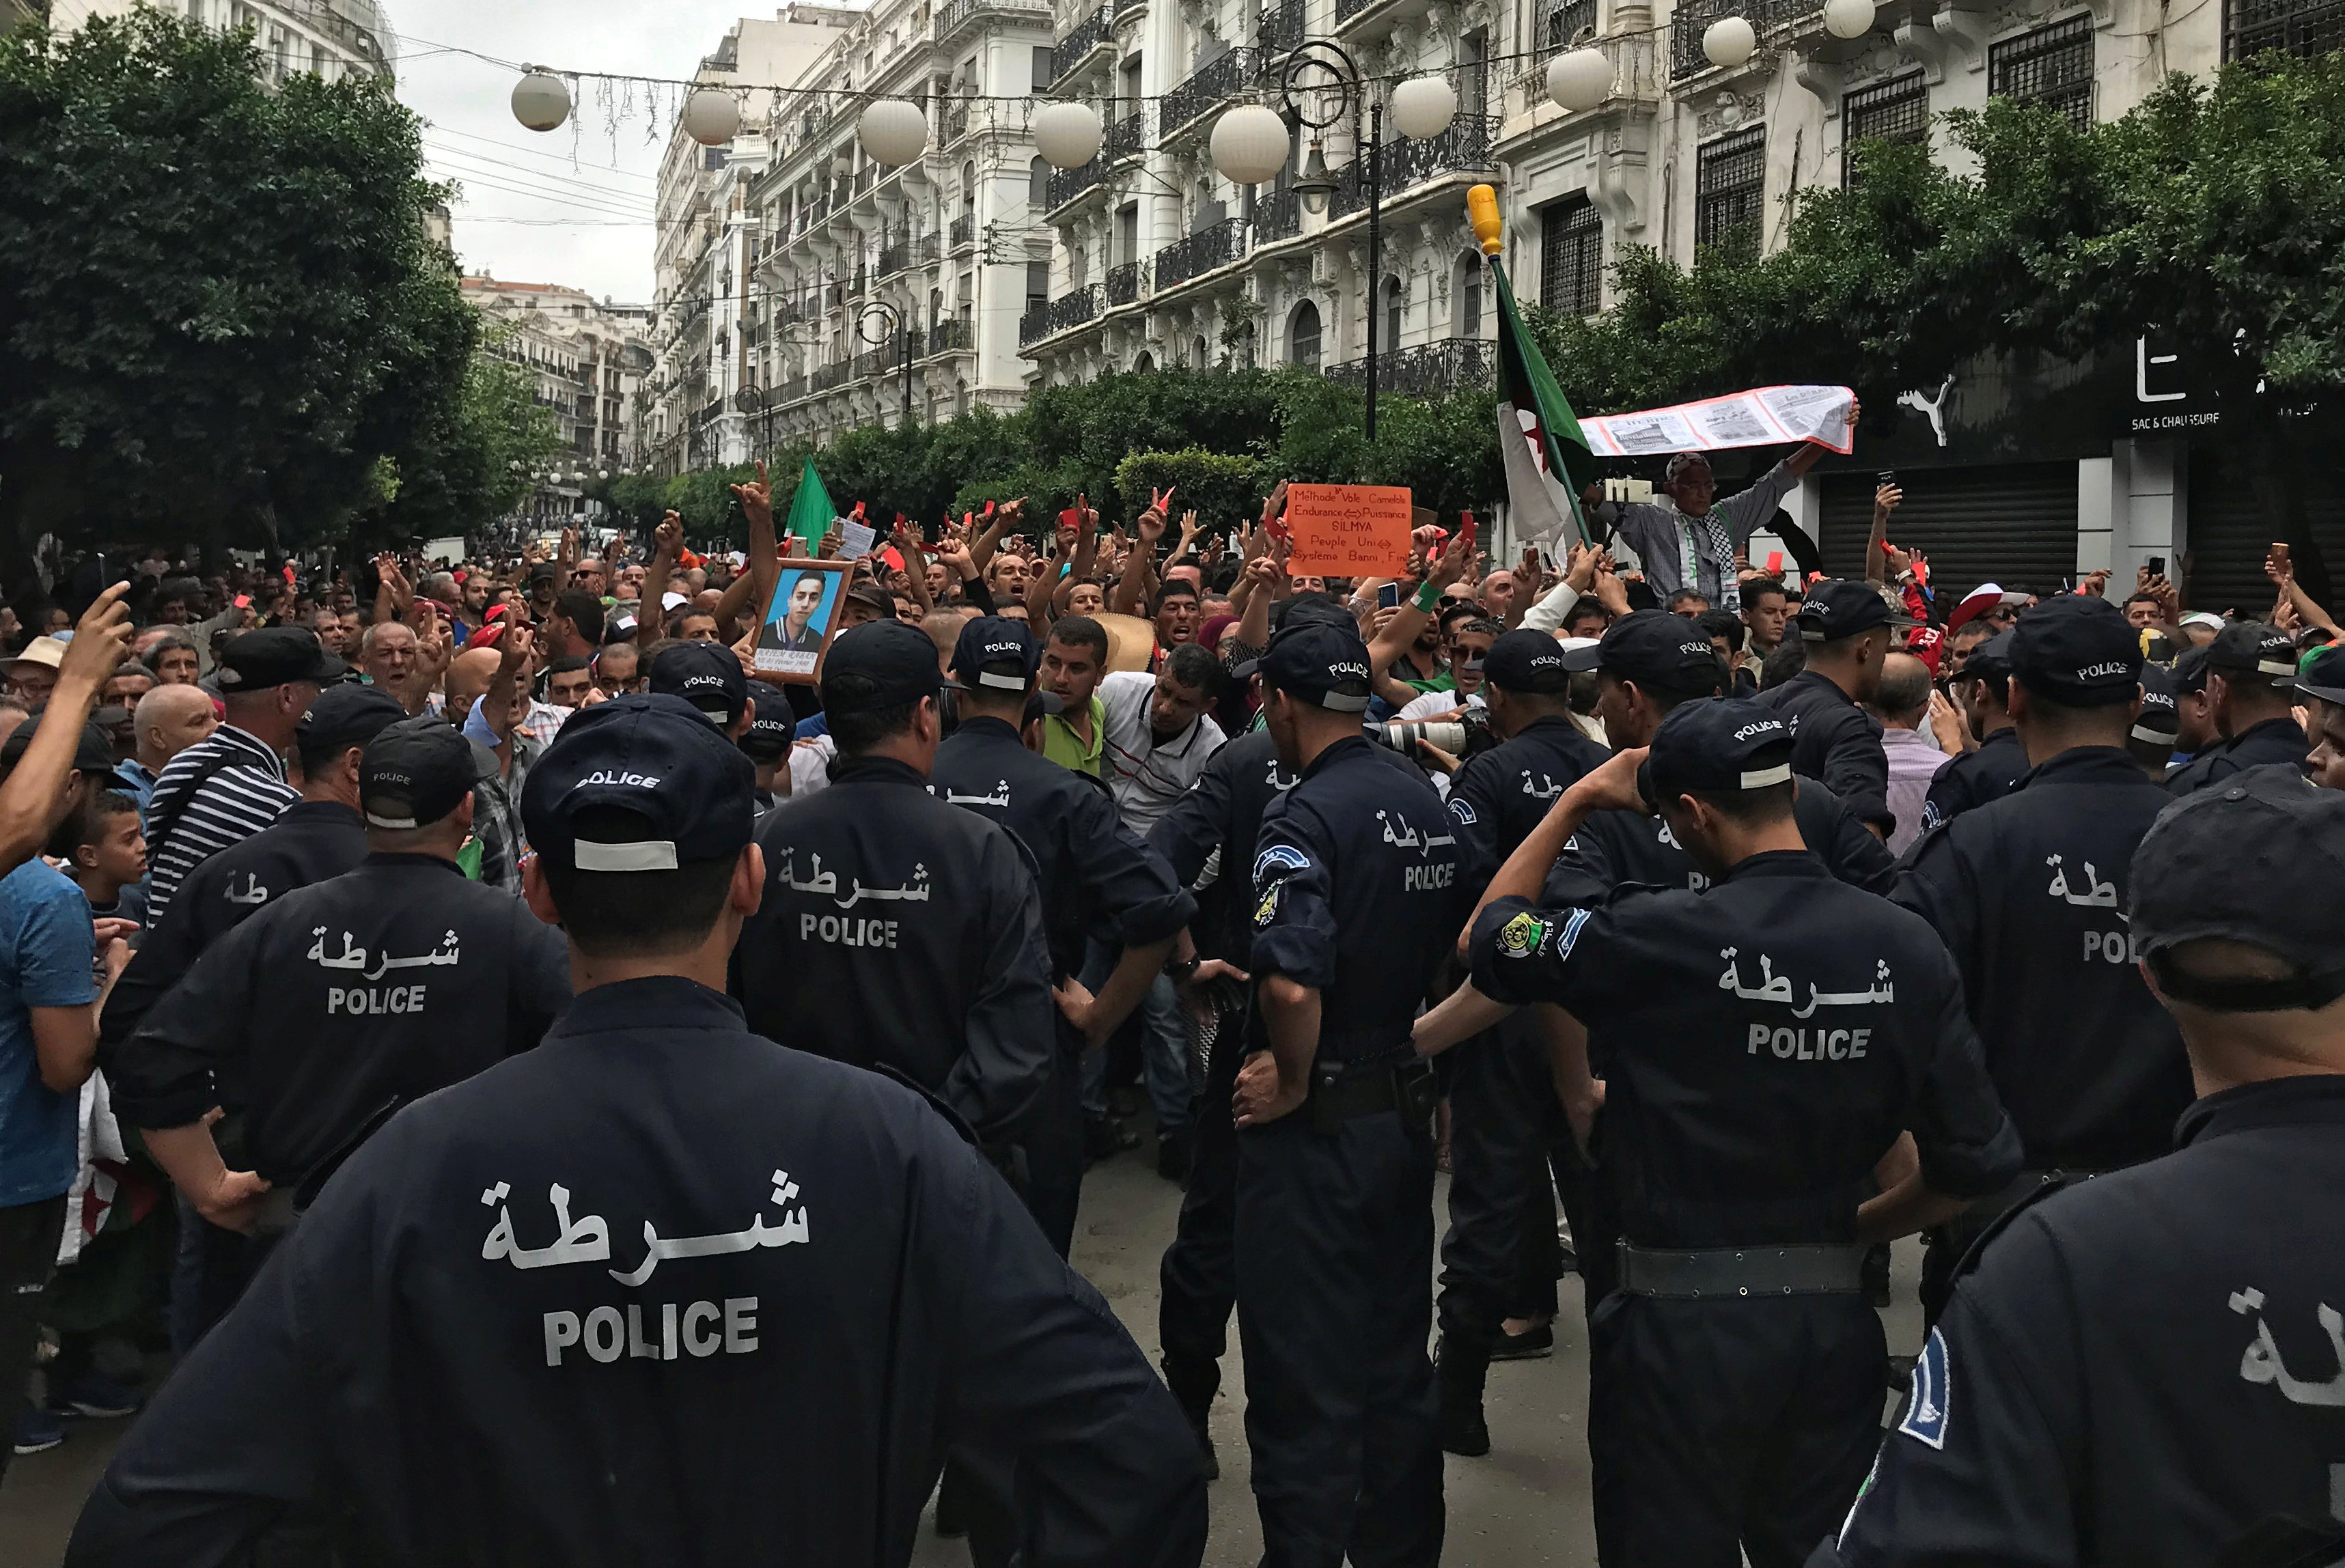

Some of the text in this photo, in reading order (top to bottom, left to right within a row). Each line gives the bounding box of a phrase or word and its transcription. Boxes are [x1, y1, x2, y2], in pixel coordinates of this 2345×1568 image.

[2132, 419, 2150, 430] SAC
[2153, 417, 2159, 428] &
[1294, 505, 1407, 519] Endurance Puissance
[1310, 535, 1376, 549] Peuple Uni
[984, 641, 1022, 653] POLICE
[1680, 642, 1712, 655] POLICE
[2260, 636, 2290, 648] POLIC
[1329, 662, 1368, 679] POLICE
[1530, 656, 1562, 667] POLICE
[2077, 662, 2128, 680] POLICE
[684, 675, 725, 688] POLICE
[1734, 720, 1783, 742] POLICE
[374, 772, 411, 785] POLICE
[572, 770, 661, 789] POLICE
[778, 845, 930, 909] شرطة
[1405, 863, 1456, 892] POLICE
[801, 912, 898, 949] POLICE
[307, 925, 459, 981] شرطة
[1719, 947, 1894, 1019] شرطة
[328, 985, 426, 1015] POLICE
[1747, 1023, 1872, 1060] POLICE
[480, 1168, 809, 1287] شرطة
[543, 1296, 758, 1367] POLICE
